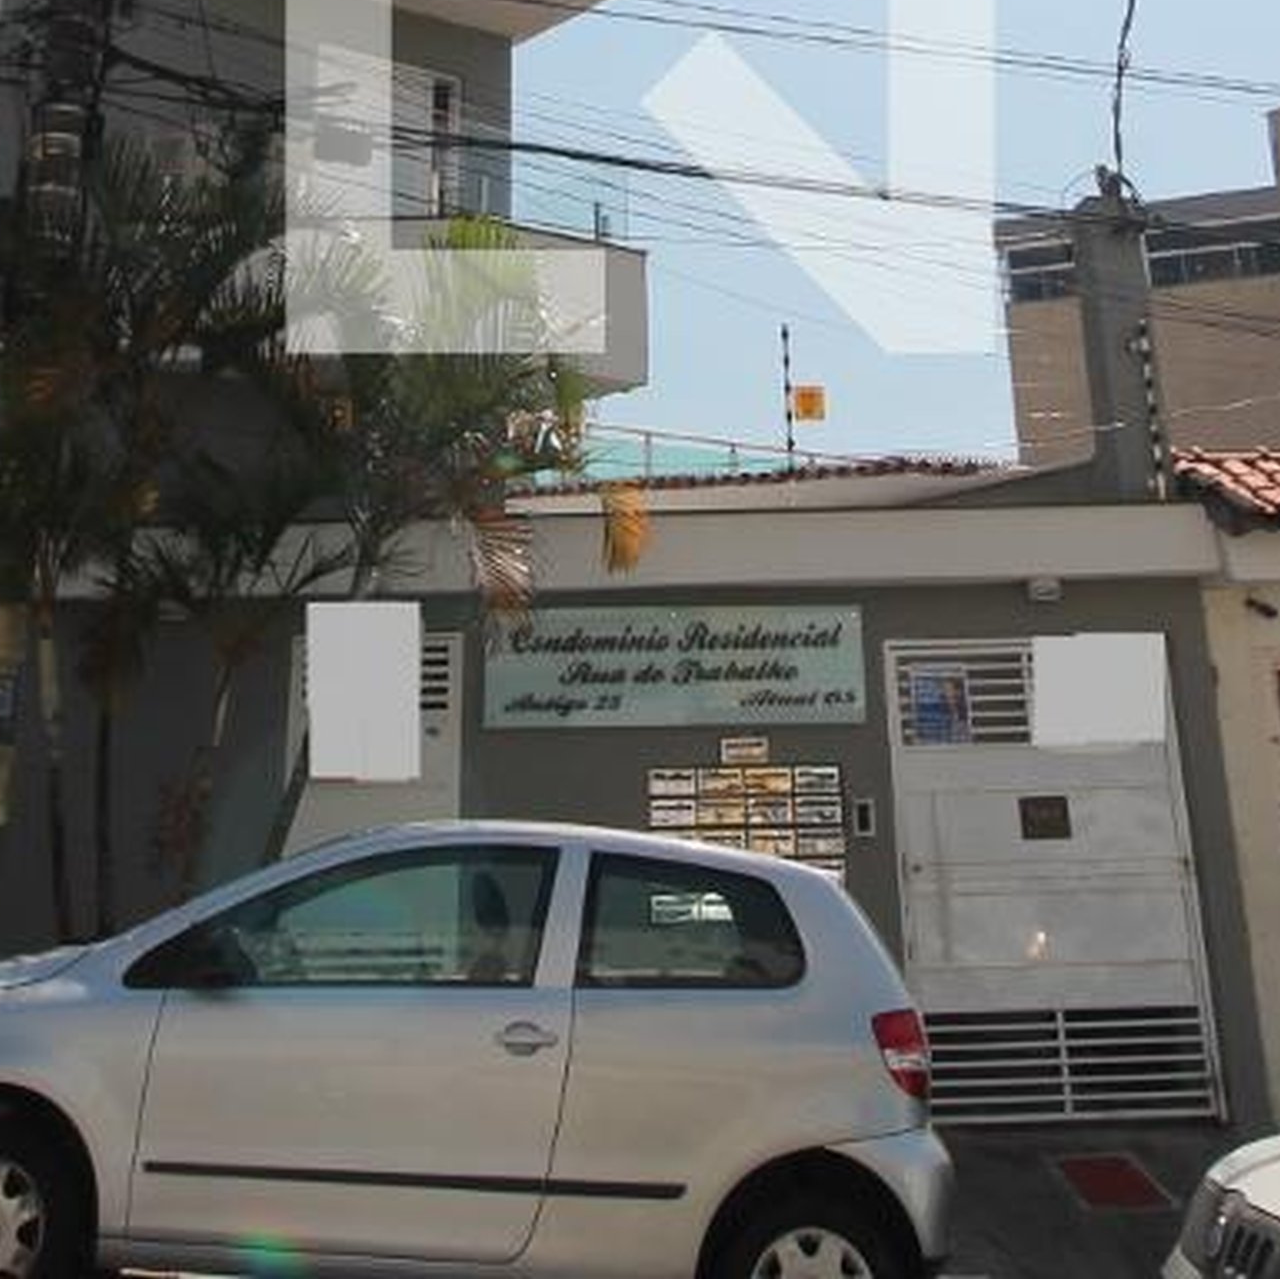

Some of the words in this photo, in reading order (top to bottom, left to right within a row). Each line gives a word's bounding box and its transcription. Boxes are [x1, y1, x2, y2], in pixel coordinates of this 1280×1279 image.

[677, 622, 842, 652] Residencial
[558, 661, 626, 685] Rua
[633, 663, 665, 684] do
[672, 659, 799, 684] Trabalho
